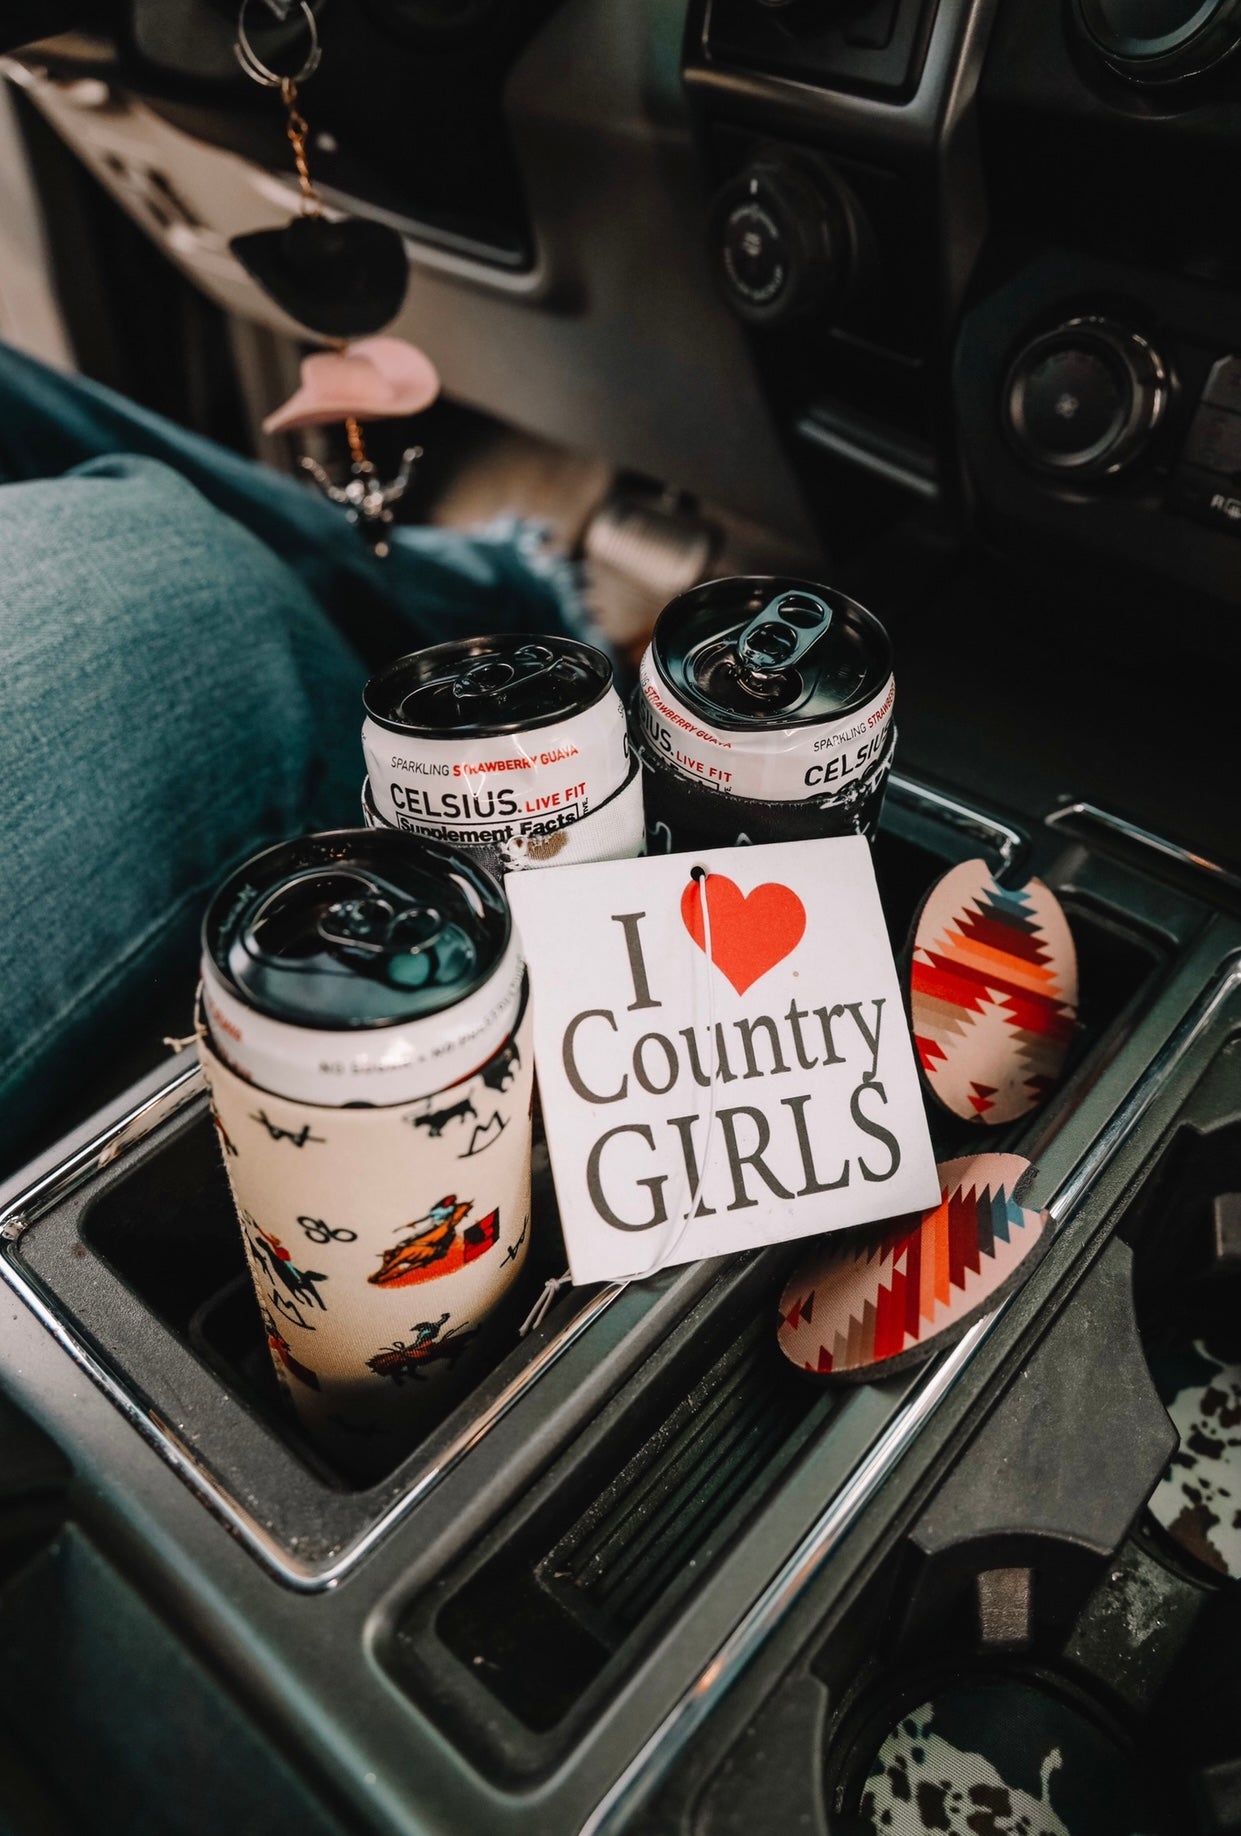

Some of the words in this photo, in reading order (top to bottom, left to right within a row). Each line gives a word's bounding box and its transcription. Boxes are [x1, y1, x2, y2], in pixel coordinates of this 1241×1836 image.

[644, 685, 697, 733] STRAWBERRY
[813, 723, 867, 752] SPARKLING
[391, 756, 449, 776] SPARKLING
[540, 744, 579, 765] GUAVA
[676, 750, 704, 773] LIVE
[709, 767, 732, 783] FIT
[525, 796, 561, 813] LIVE
[565, 782, 586, 804] FIT
[399, 817, 514, 842] Supplement
[520, 811, 576, 837] Facts
[611, 911, 662, 1012] I
[561, 997, 887, 1105] Country
[586, 1080, 901, 1232] GIRLS
